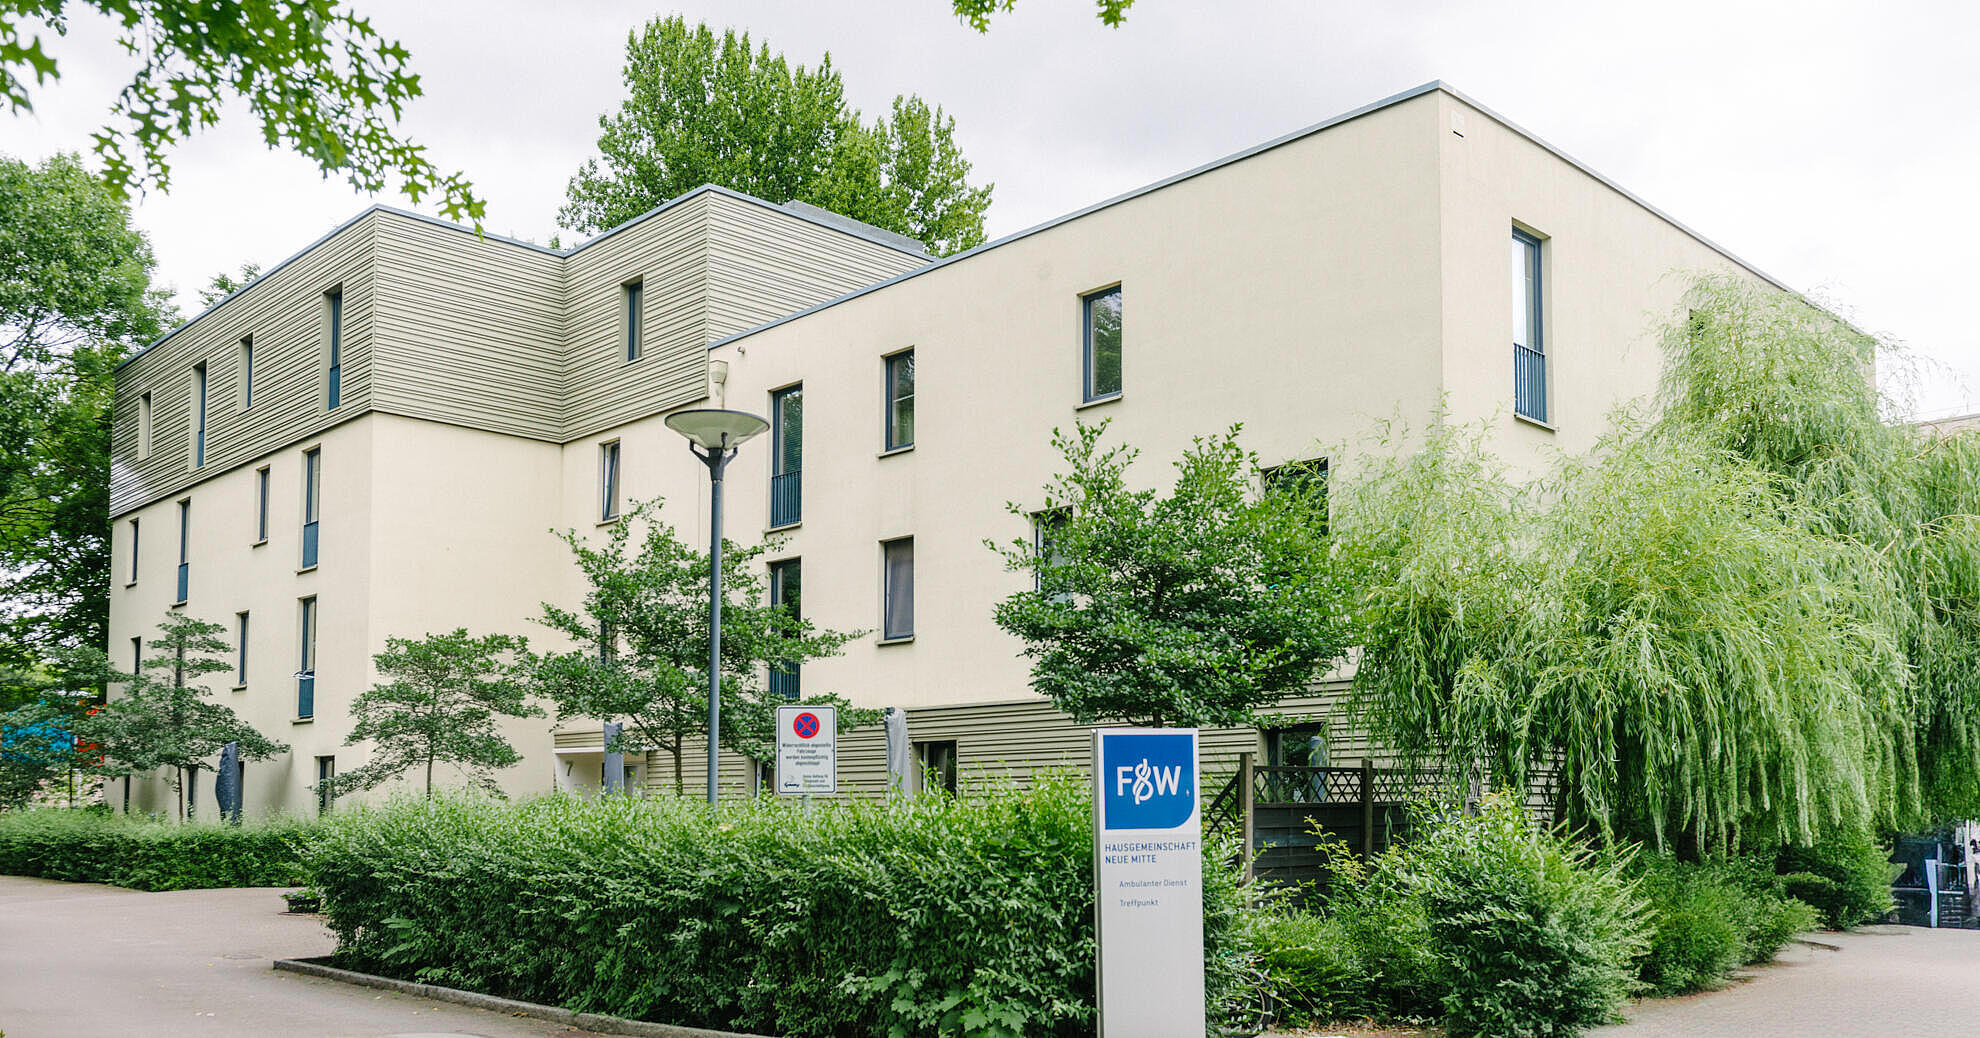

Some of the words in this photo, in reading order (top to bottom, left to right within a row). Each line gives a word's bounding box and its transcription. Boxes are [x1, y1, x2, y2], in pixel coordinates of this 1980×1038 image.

[565, 760, 575, 776] 7
[1117, 758, 1181, 805] F&W
[1105, 842, 1196, 852] HAUSGEMEINSCHAFT
[1105, 855, 1129, 864] NEUE
[1131, 854, 1156, 864] MITTE
[1119, 880, 1162, 888] Ambulanter
[1164, 879, 1187, 887] Dienst
[1119, 898, 1159, 908] Treffpunkt
